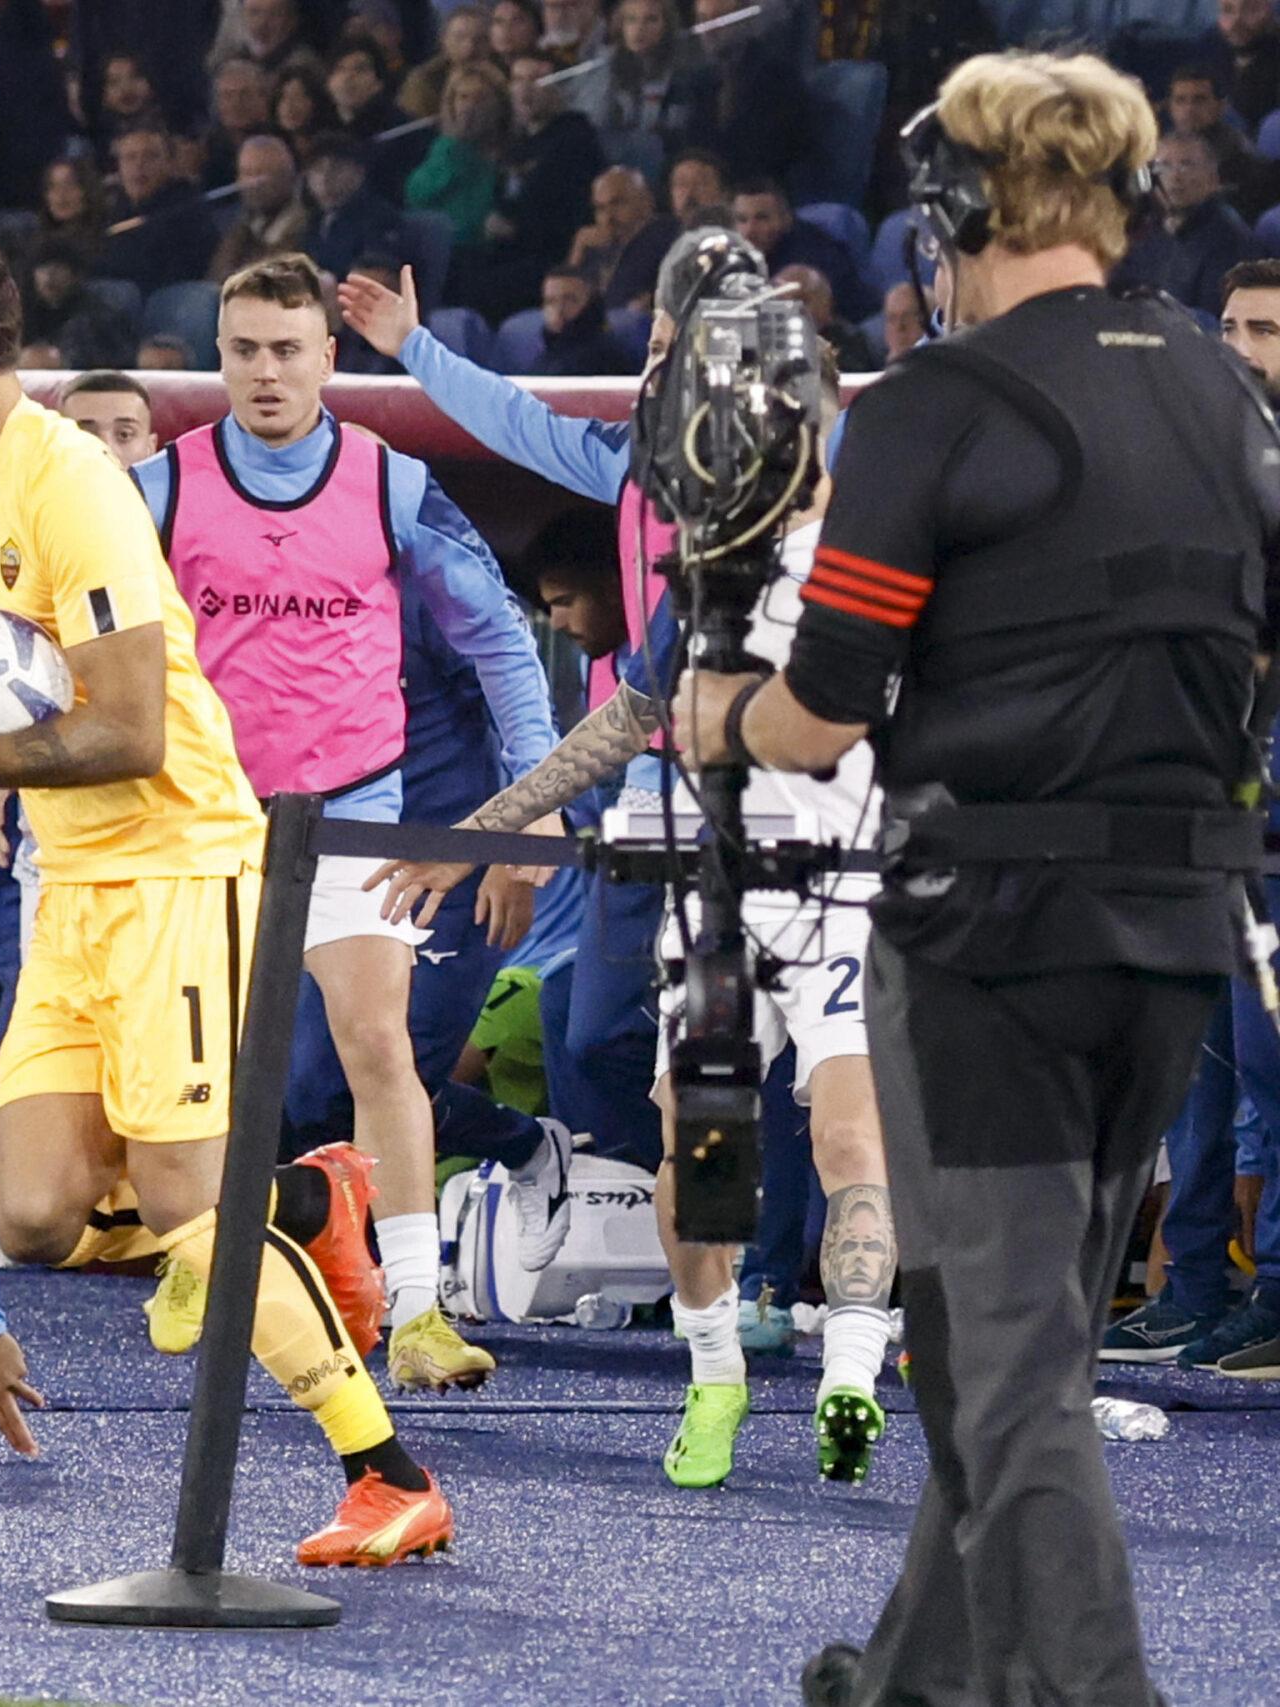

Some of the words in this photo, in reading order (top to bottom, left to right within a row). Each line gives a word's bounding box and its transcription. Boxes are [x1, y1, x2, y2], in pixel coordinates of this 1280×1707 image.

[233, 594, 362, 619] BINANCE
[823, 956, 861, 1017] 2
[181, 985, 204, 1063] 1
